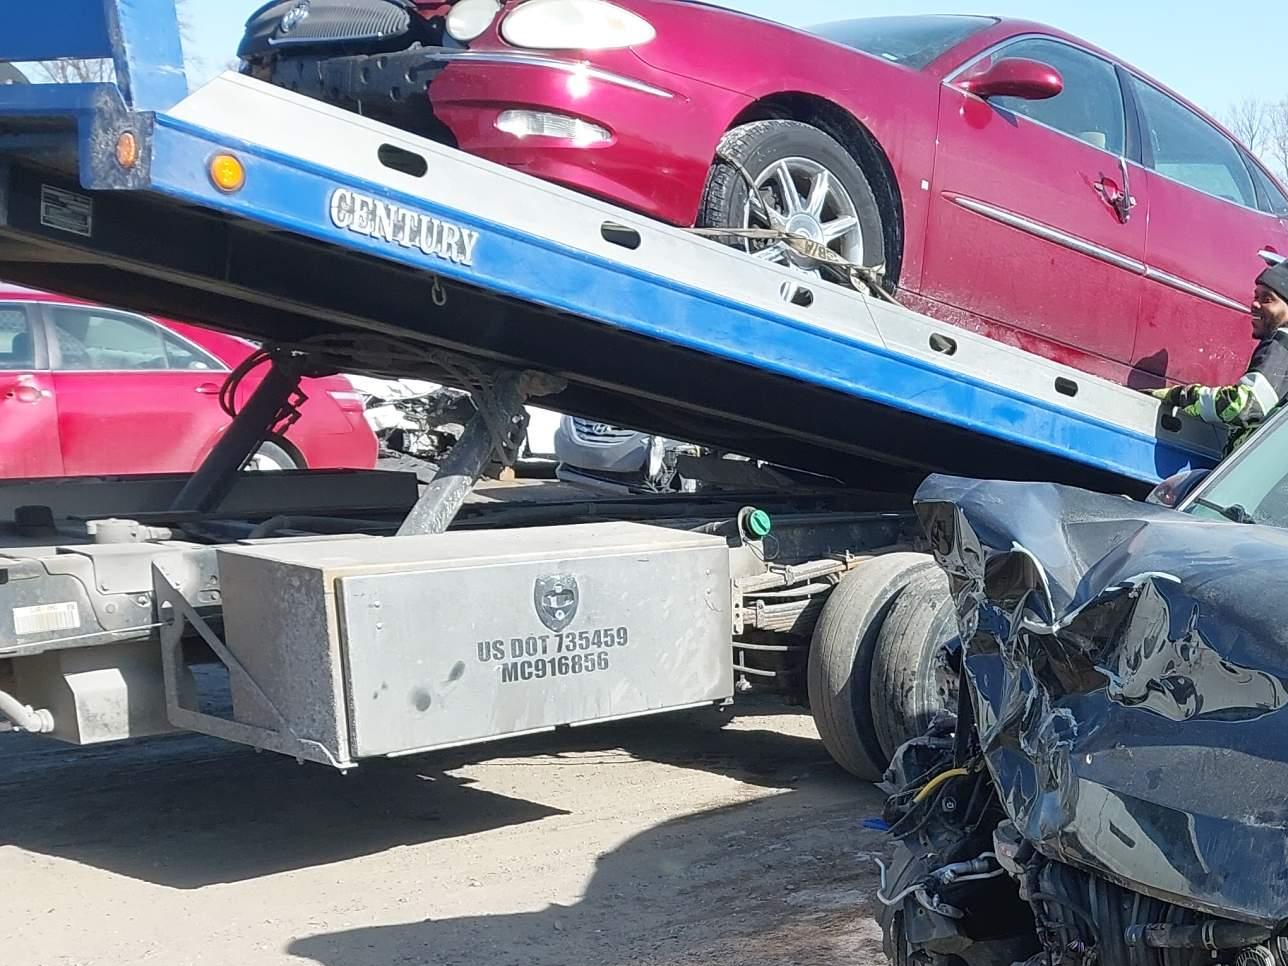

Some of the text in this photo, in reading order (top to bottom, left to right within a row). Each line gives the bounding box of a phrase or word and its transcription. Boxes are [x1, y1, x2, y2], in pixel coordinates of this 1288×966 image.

[329, 187, 480, 267] CENTURY
[477, 626, 628, 662] US DOT 735459
[501, 651, 609, 683] MC916856
